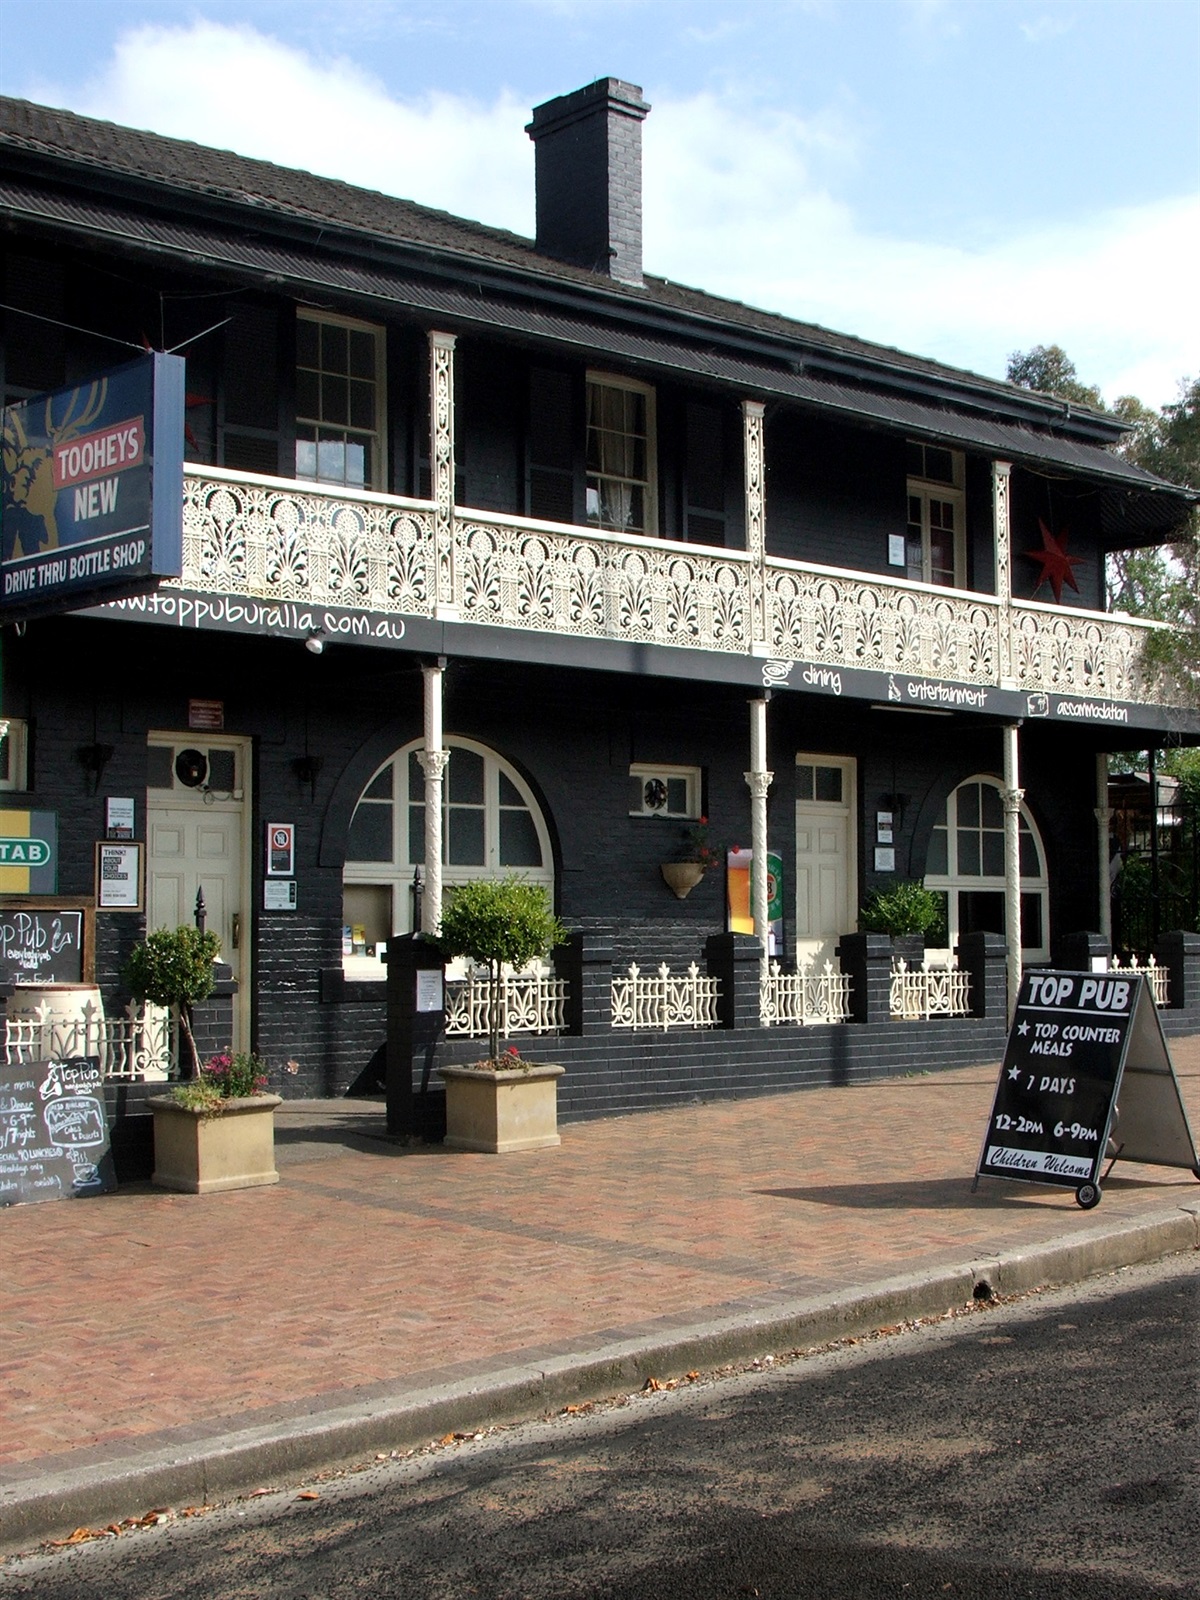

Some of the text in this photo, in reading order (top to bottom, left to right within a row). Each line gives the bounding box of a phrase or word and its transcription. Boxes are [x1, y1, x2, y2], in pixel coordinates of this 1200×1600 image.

[58, 427, 139, 480] TOOHEYS
[74, 477, 119, 522] NEW
[5, 540, 145, 595] DRIVE THRU BOTTLE SHOP
[802, 665, 842, 695] dining
[907, 683, 988, 707] entertainment
[0, 844, 42, 860] TAB
[13, 912, 47, 949] Pub
[1028, 976, 1130, 1010] TOP PUB
[1034, 1023, 1121, 1043] TOP COUNTER
[1029, 1040, 1073, 1057] MEALS
[1026, 1075, 1076, 1094] 7 DAYS
[995, 1114, 1098, 1141] 12-2PM 6-9PM
[990, 1148, 1090, 1177] Children Welcome
